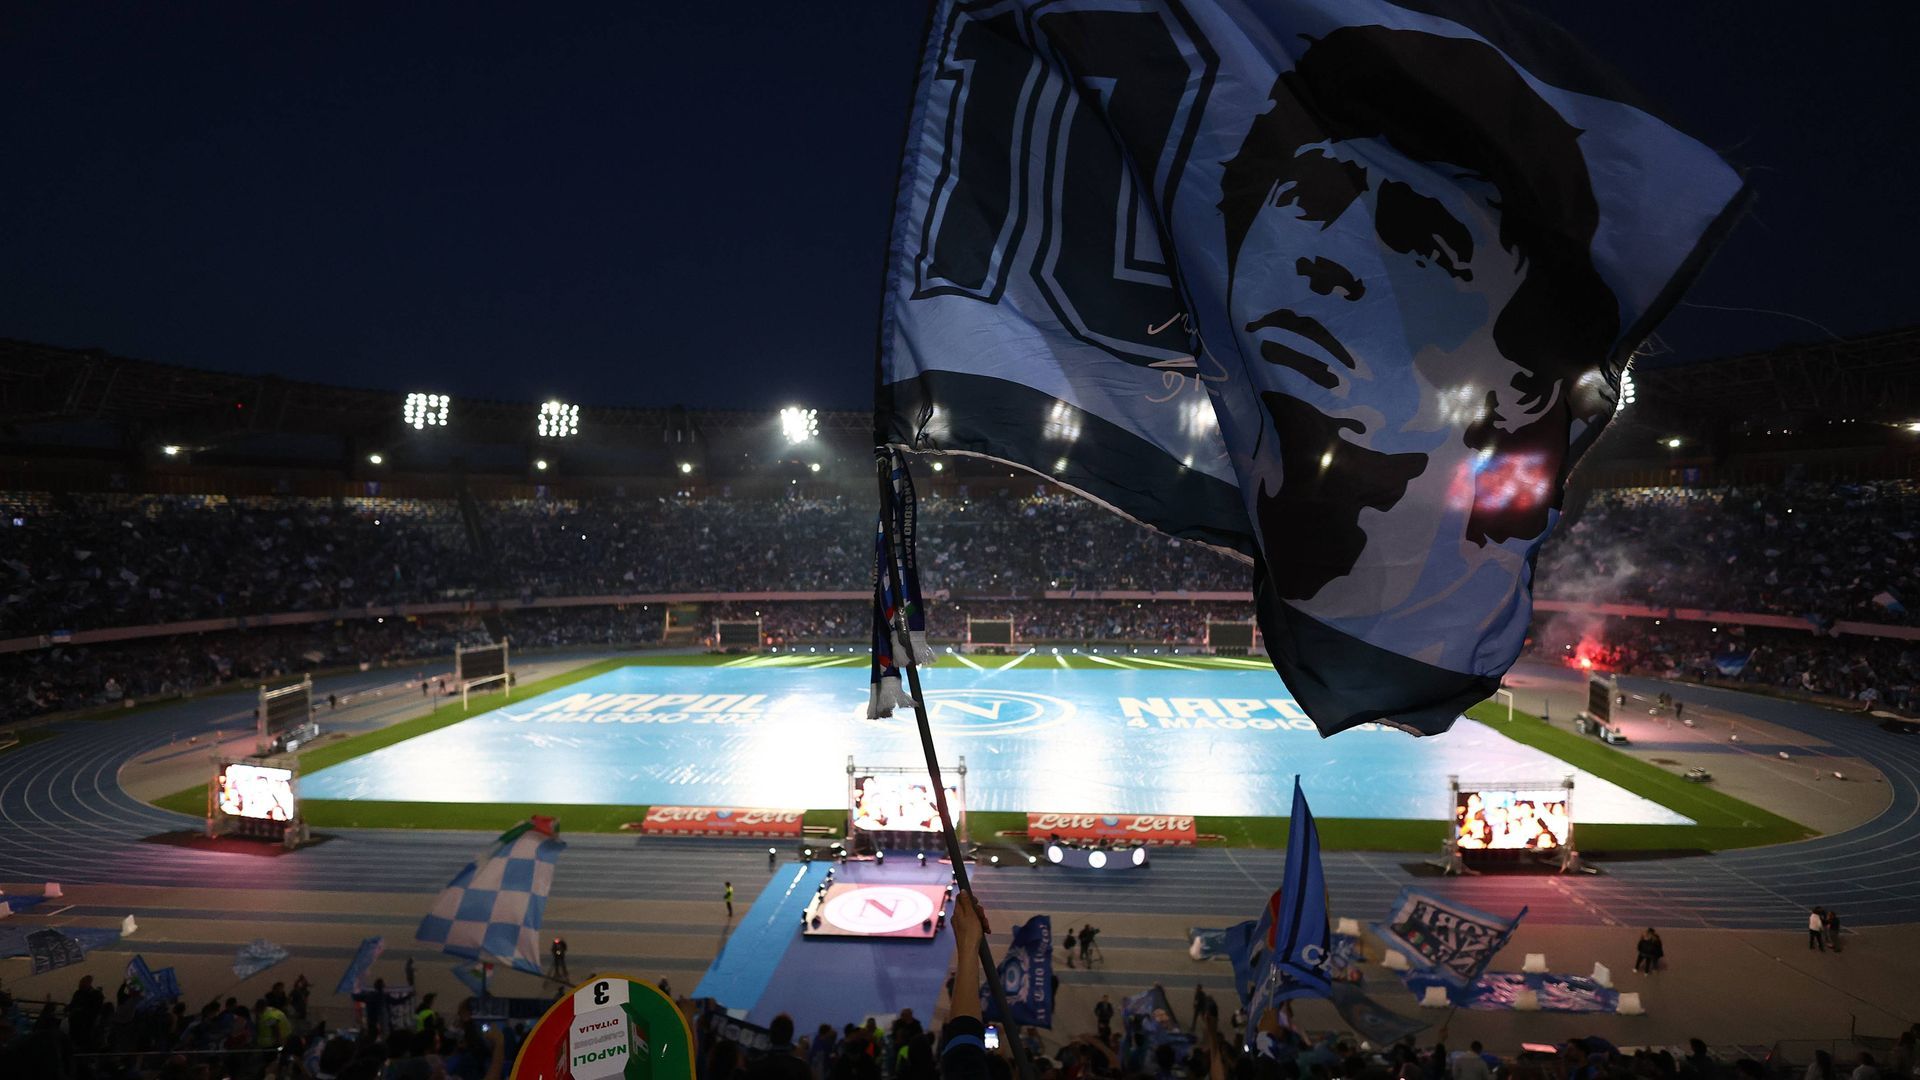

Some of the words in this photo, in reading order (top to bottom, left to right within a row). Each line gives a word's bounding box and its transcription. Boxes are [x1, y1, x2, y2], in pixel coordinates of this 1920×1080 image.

[909, 0, 1220, 368] 10
[903, 505, 913, 535] SONO
[539, 712, 690, 724] MAGGIO
[1126, 717, 1149, 729] 4
[1159, 717, 1318, 731] MAGGIO
[646, 807, 711, 823] Lete
[736, 809, 800, 825] Lete
[1030, 814, 1096, 830] Lete
[1126, 816, 1192, 832] Lete
[593, 981, 610, 1005] 3
[579, 1018, 619, 1034] D'ITALIA
[573, 1044, 627, 1067] NAPOLI
